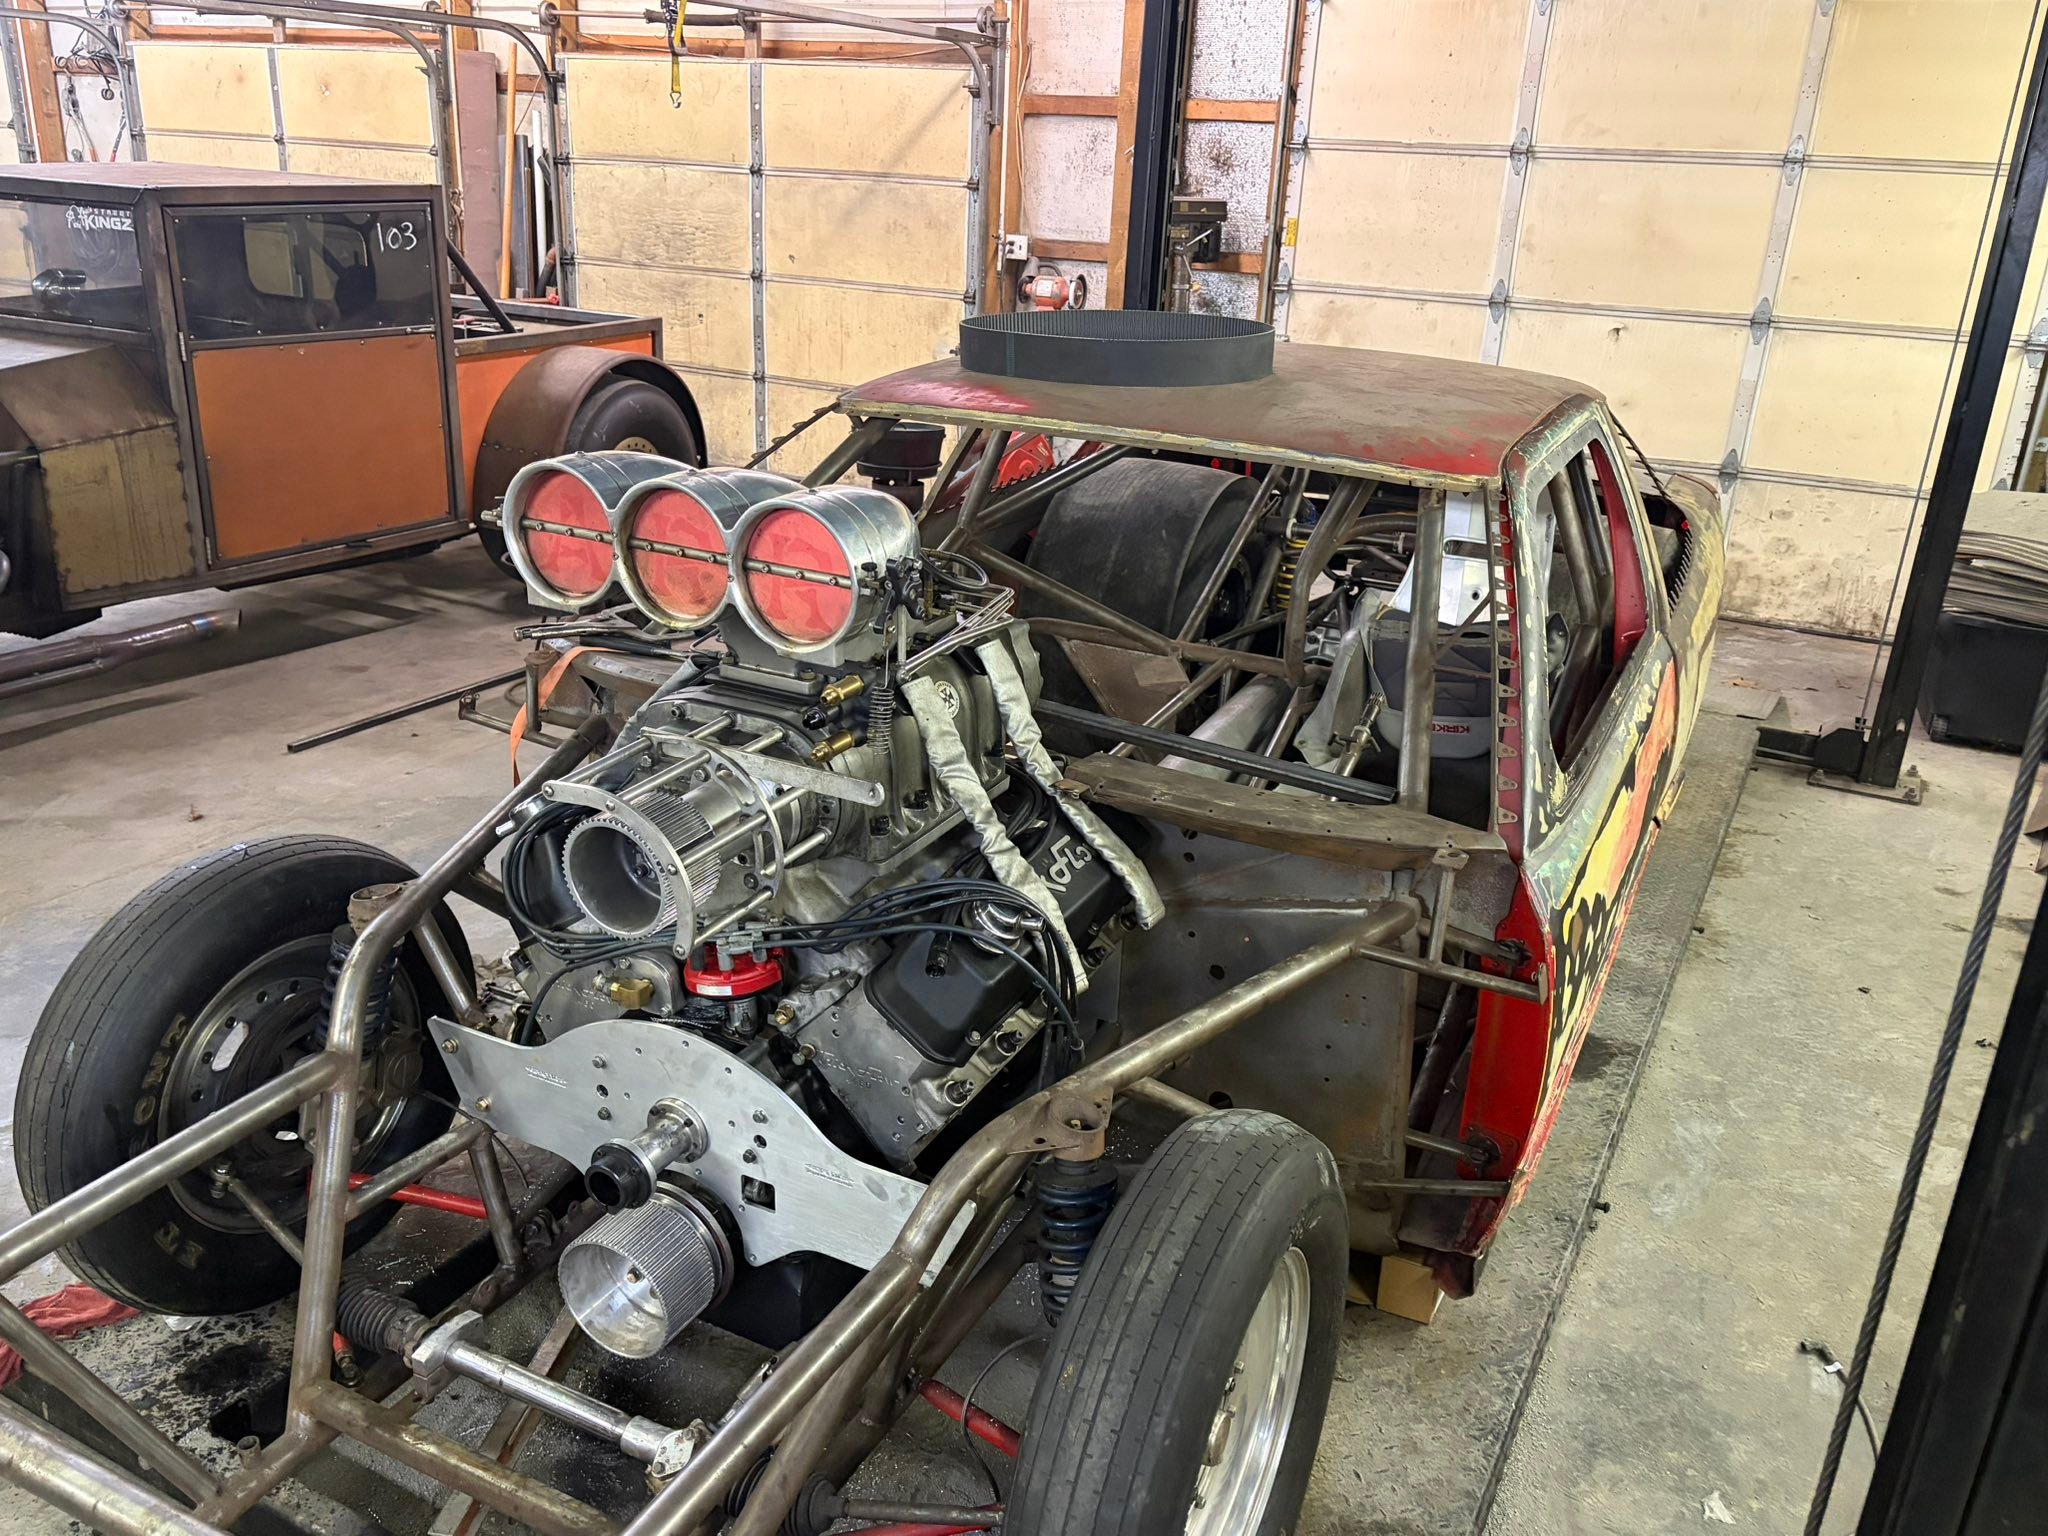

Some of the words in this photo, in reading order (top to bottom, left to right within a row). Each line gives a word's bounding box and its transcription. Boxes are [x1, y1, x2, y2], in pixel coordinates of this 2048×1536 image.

[94, 208, 130, 216] STREET
[85, 214, 134, 231] KINGZ
[376, 222, 417, 252] 103
